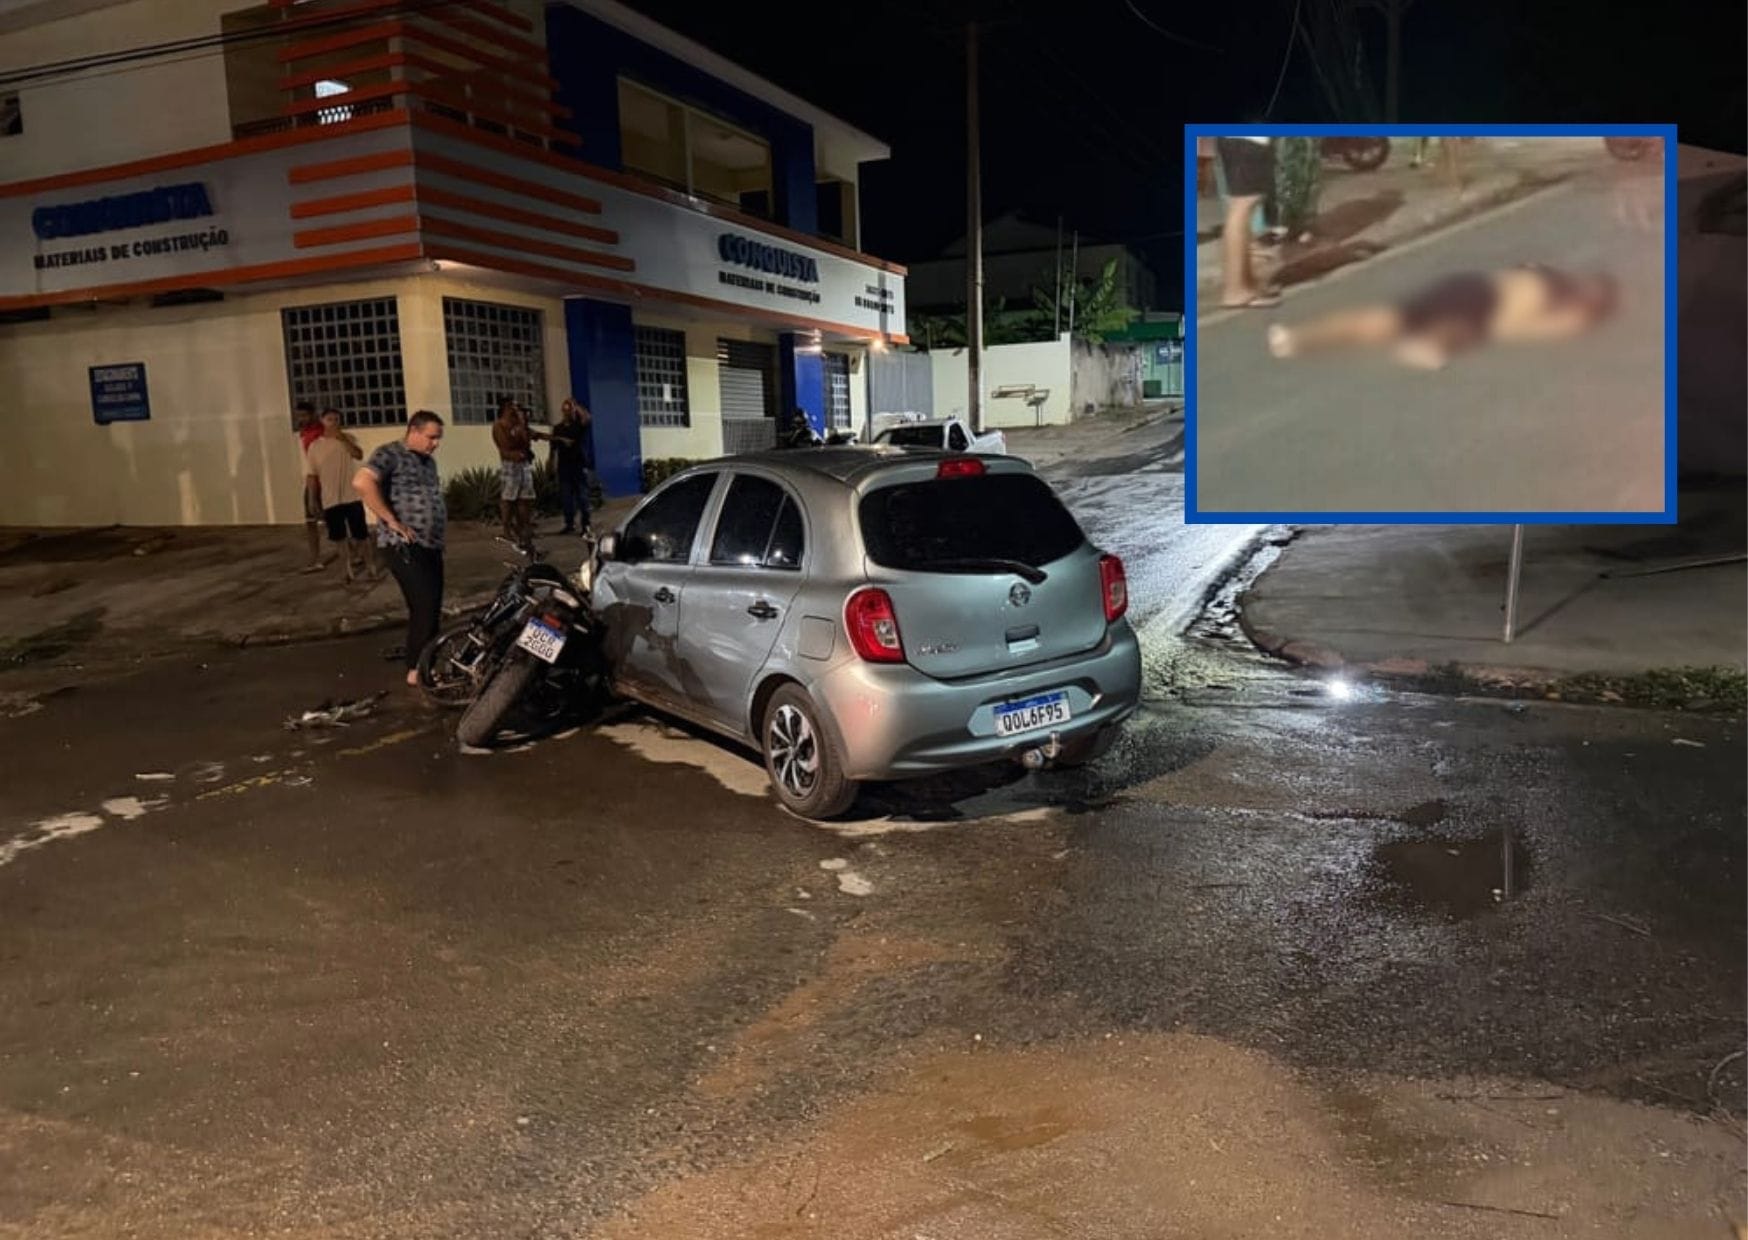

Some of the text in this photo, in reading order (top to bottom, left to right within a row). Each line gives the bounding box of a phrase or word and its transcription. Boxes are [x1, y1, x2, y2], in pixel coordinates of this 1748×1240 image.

[34, 226, 229, 270] MATERIAIS DE CONSTRUÇÃO
[718, 233, 819, 283] CONQUISTA
[1003, 703, 1063, 732] QOL6F95
